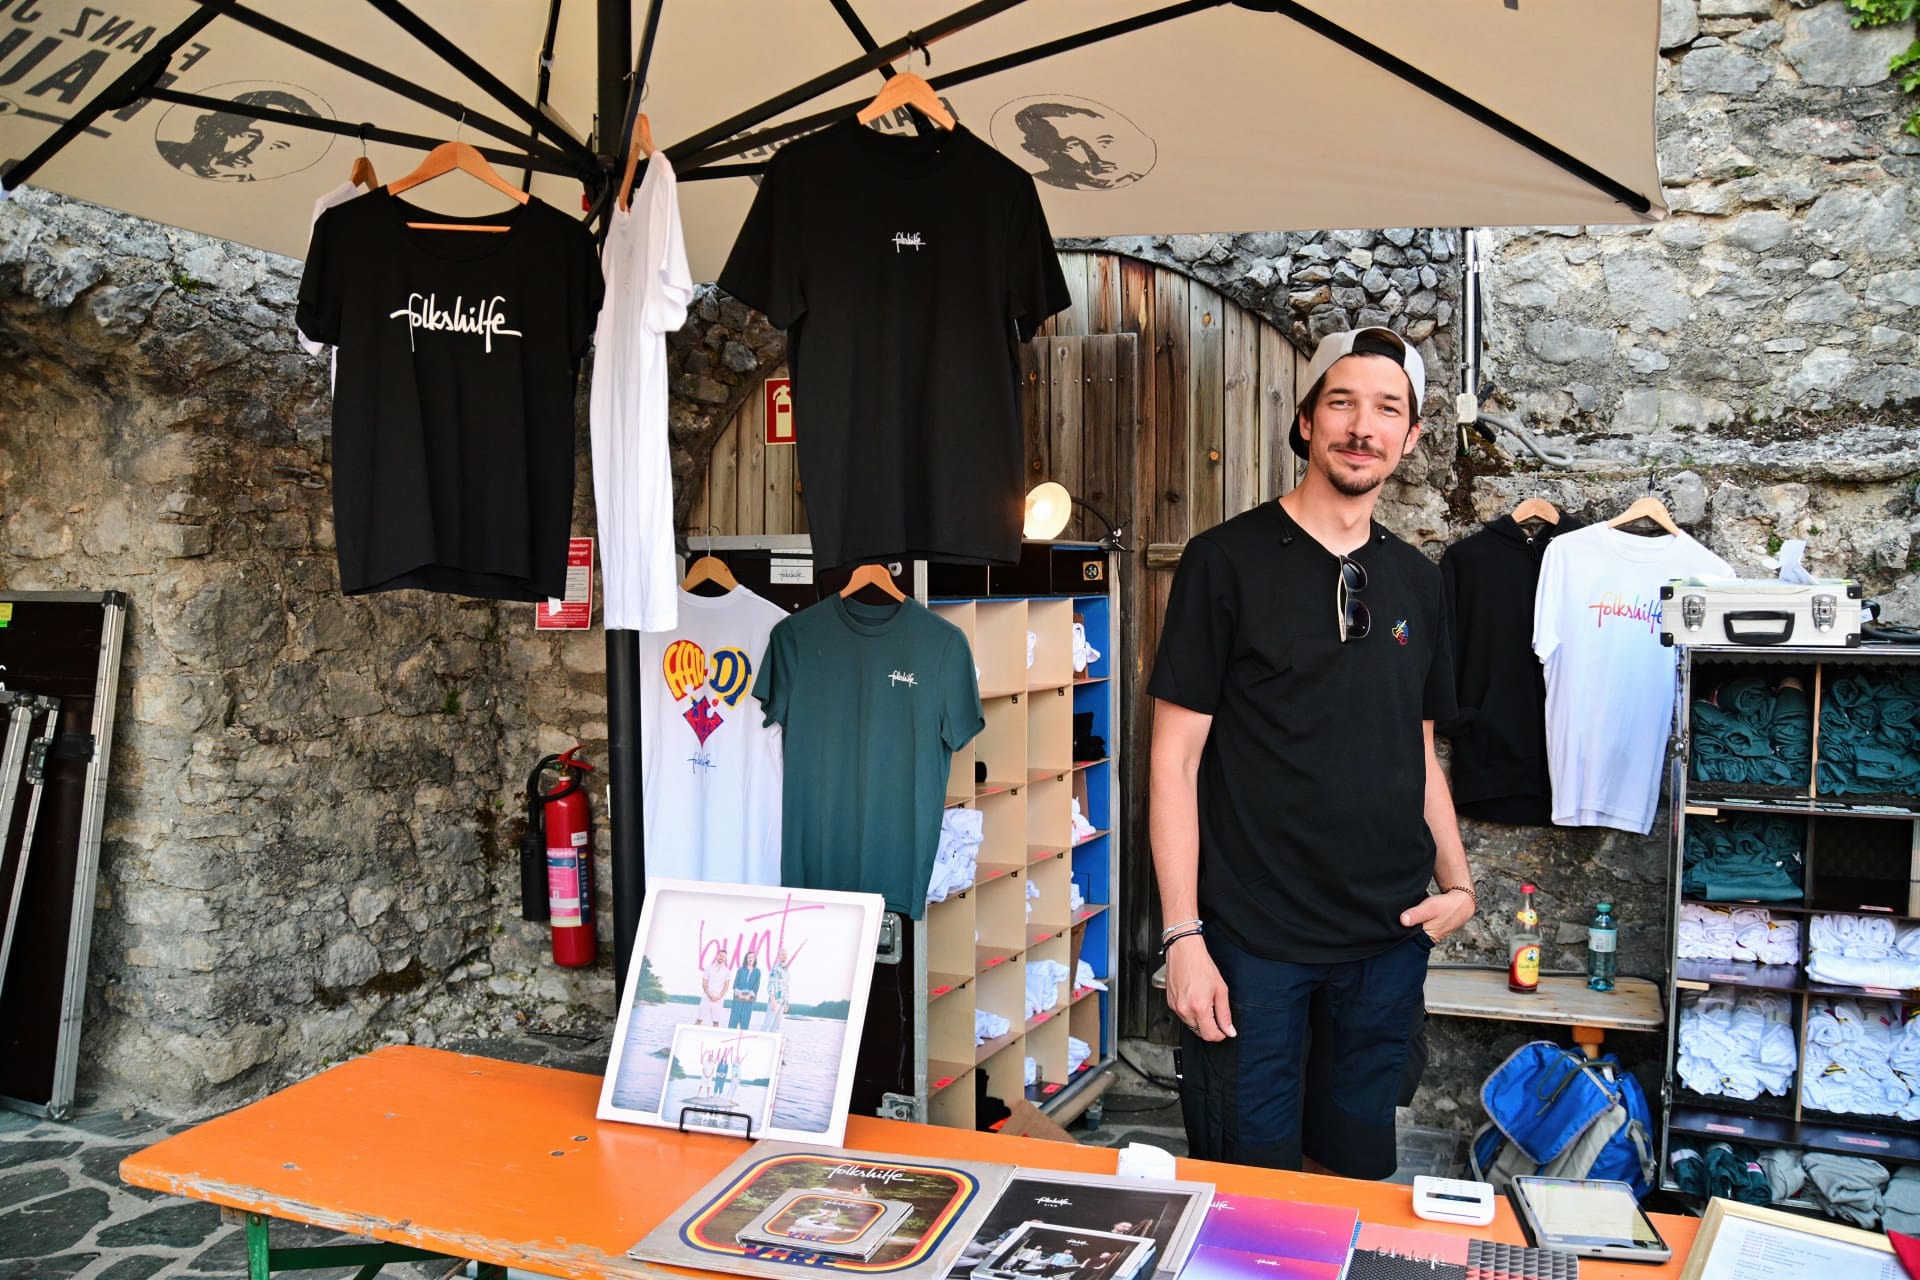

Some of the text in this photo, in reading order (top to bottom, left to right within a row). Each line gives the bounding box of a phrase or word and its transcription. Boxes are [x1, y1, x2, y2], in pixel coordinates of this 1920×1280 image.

[390, 292, 523, 354] folkshilfe
[698, 892, 825, 973] bunt
[700, 1029, 758, 1065] bunt
[822, 1163, 914, 1186] folkshilfe
